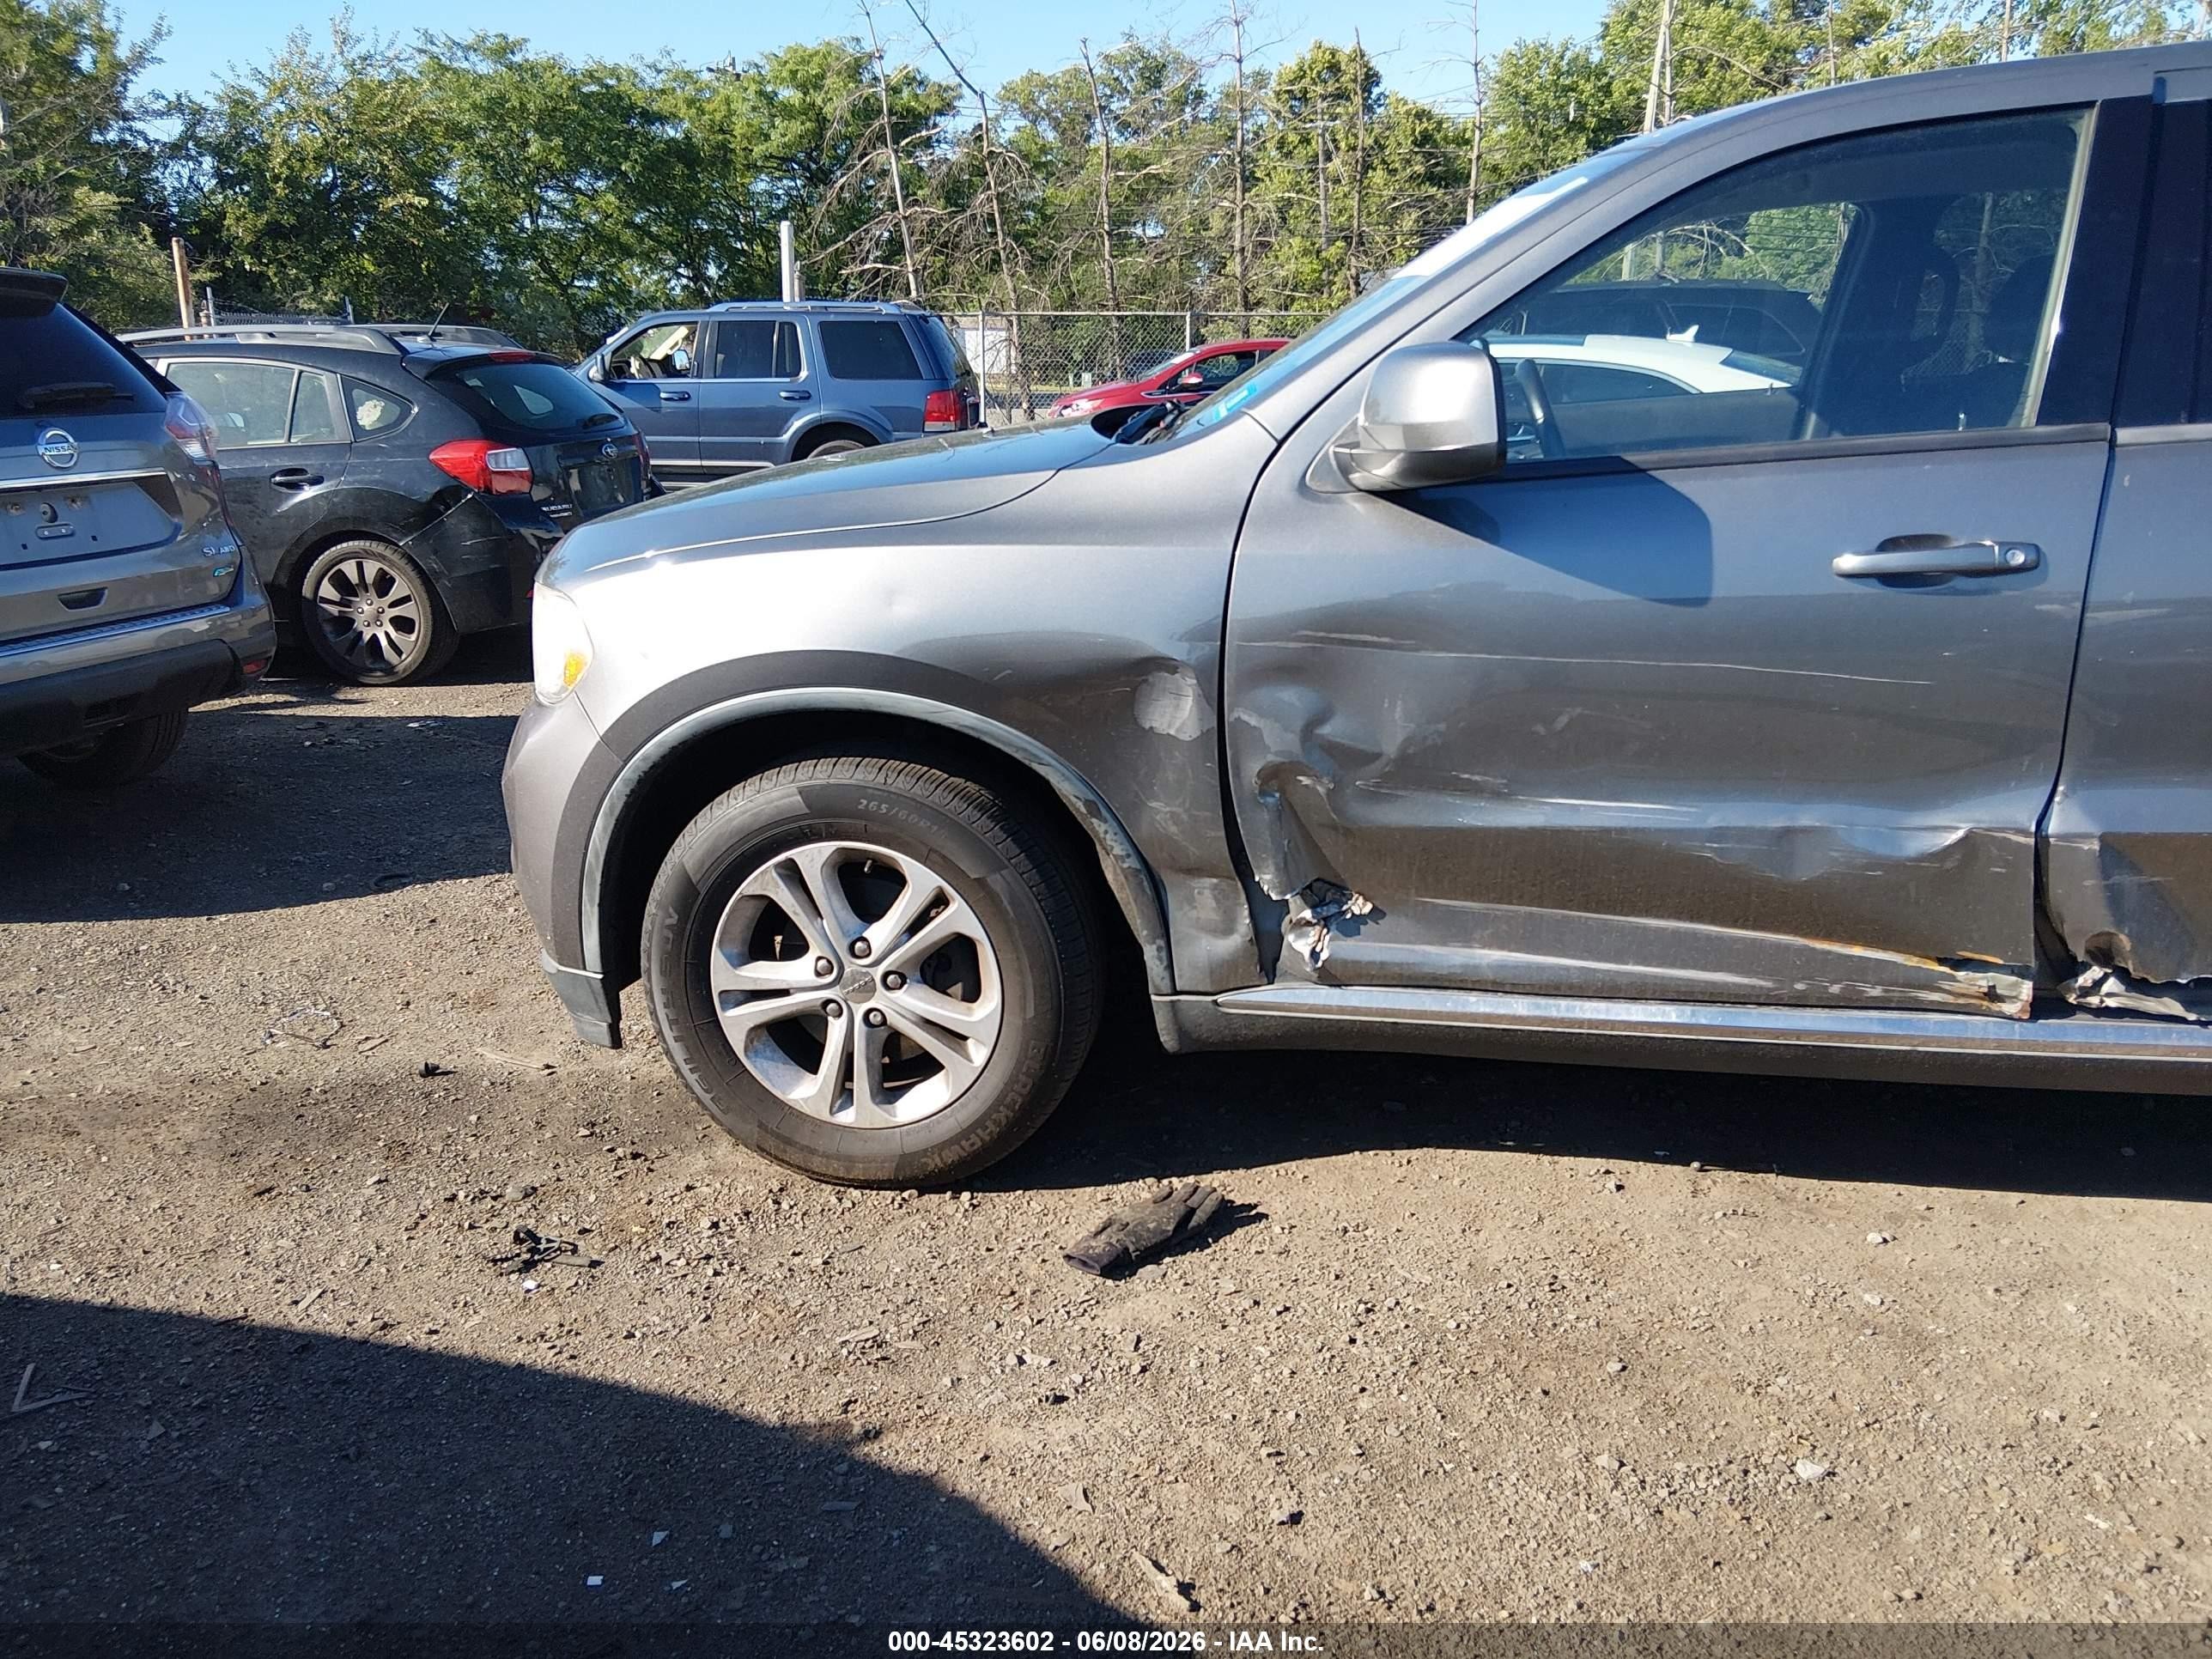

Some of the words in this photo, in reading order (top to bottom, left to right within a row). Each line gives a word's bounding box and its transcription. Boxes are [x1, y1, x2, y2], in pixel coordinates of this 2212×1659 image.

[44, 444, 78, 453] NISSAN
[858, 798, 950, 840] 265/60R1
[659, 906, 679, 978] SUV
[919, 1040, 1050, 1171] BLACKHAWK
